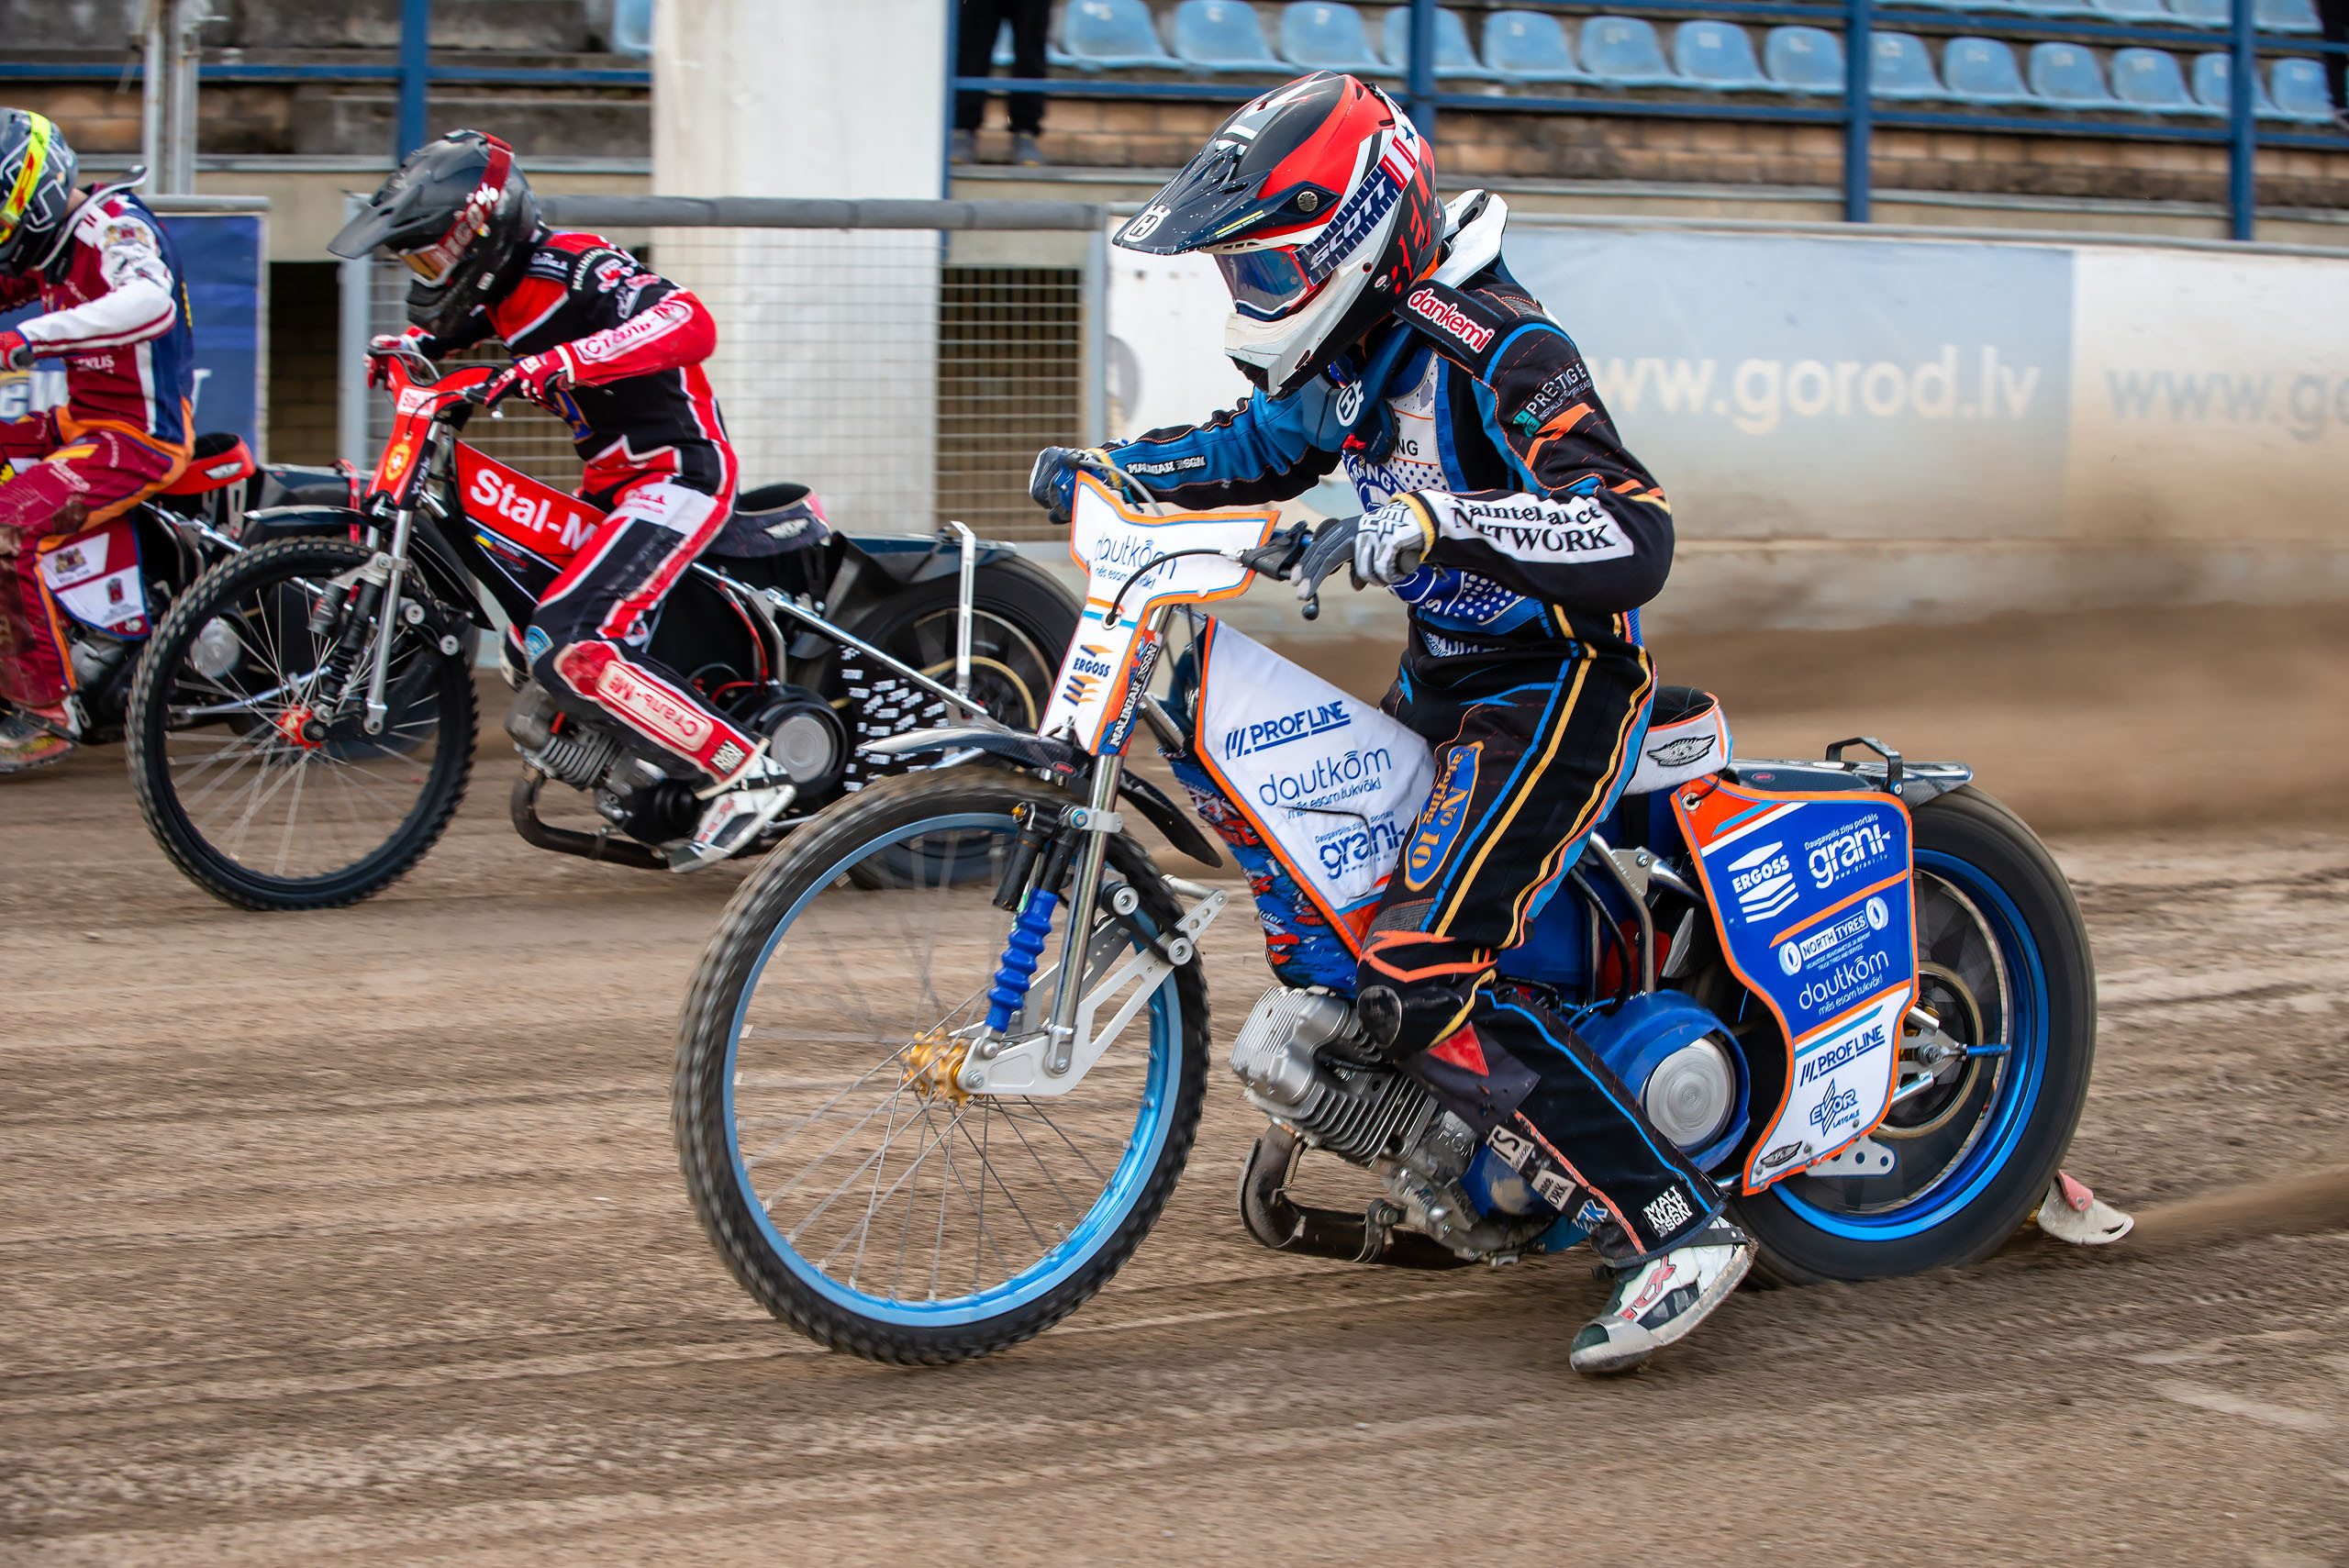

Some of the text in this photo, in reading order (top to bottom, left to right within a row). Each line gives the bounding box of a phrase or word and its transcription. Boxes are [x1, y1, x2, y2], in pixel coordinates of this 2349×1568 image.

[1309, 176, 1386, 271] SCOTT
[1408, 288, 1494, 352] dankemi
[1073, 657, 1111, 678] ERGOSS
[1804, 828, 1840, 851] Daugavpils
[1731, 854, 1789, 894] ERGOSS
[1802, 915, 1865, 957] NORTH TYRES
